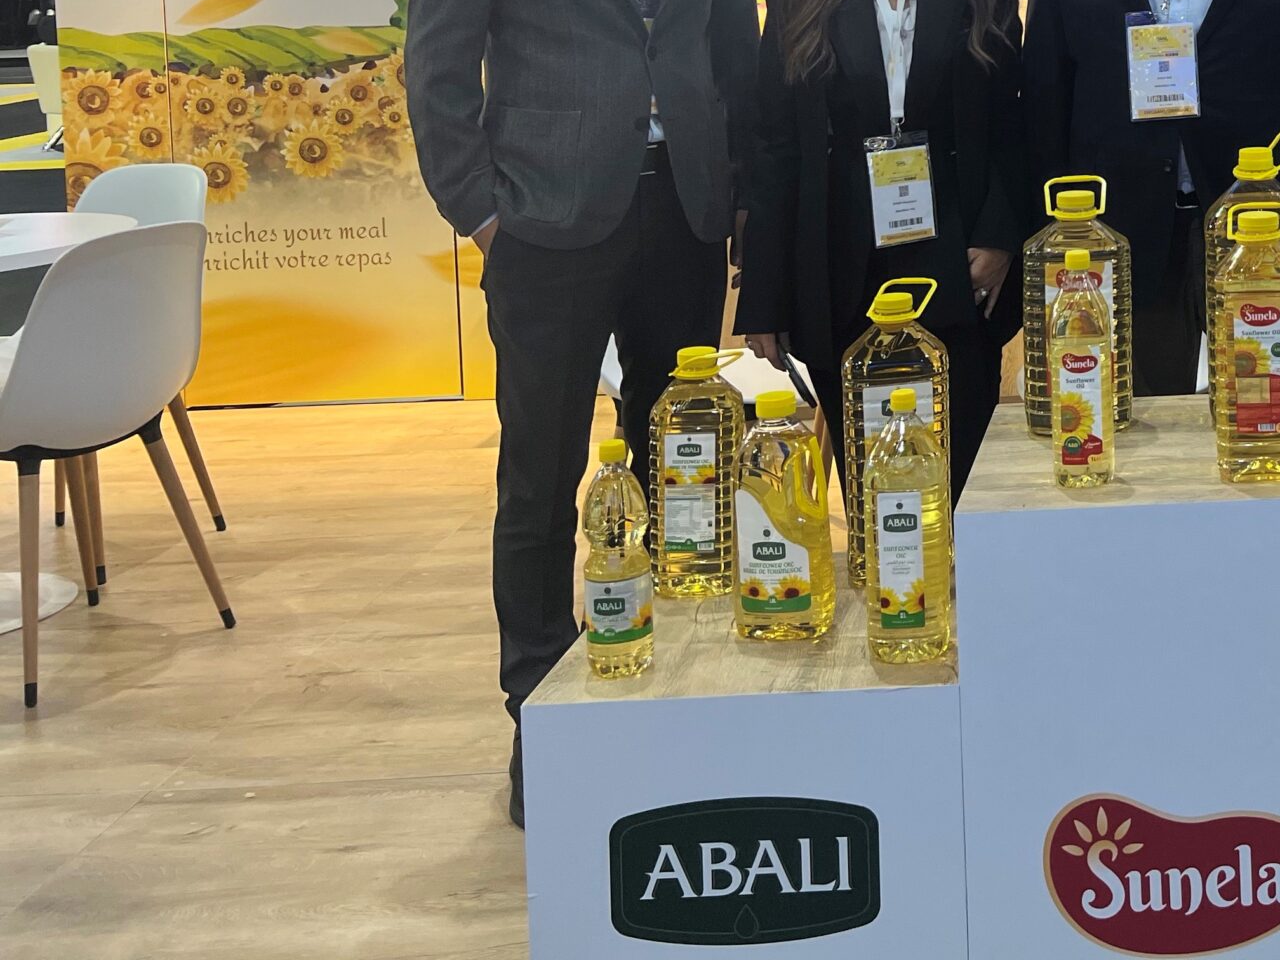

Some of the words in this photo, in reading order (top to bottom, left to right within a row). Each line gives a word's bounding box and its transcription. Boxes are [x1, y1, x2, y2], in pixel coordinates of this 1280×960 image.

[283, 227, 332, 248] your
[338, 216, 389, 240] meal
[275, 249, 329, 269] votre
[335, 251, 392, 272] repas
[1244, 310, 1278, 322] Sunela
[1065, 358, 1095, 369] Sunela
[679, 446, 700, 454] ABALI
[887, 518, 914, 527] ABALI
[755, 546, 783, 556] ABALI
[596, 601, 623, 611] ABALI
[640, 836, 853, 901] ABALI
